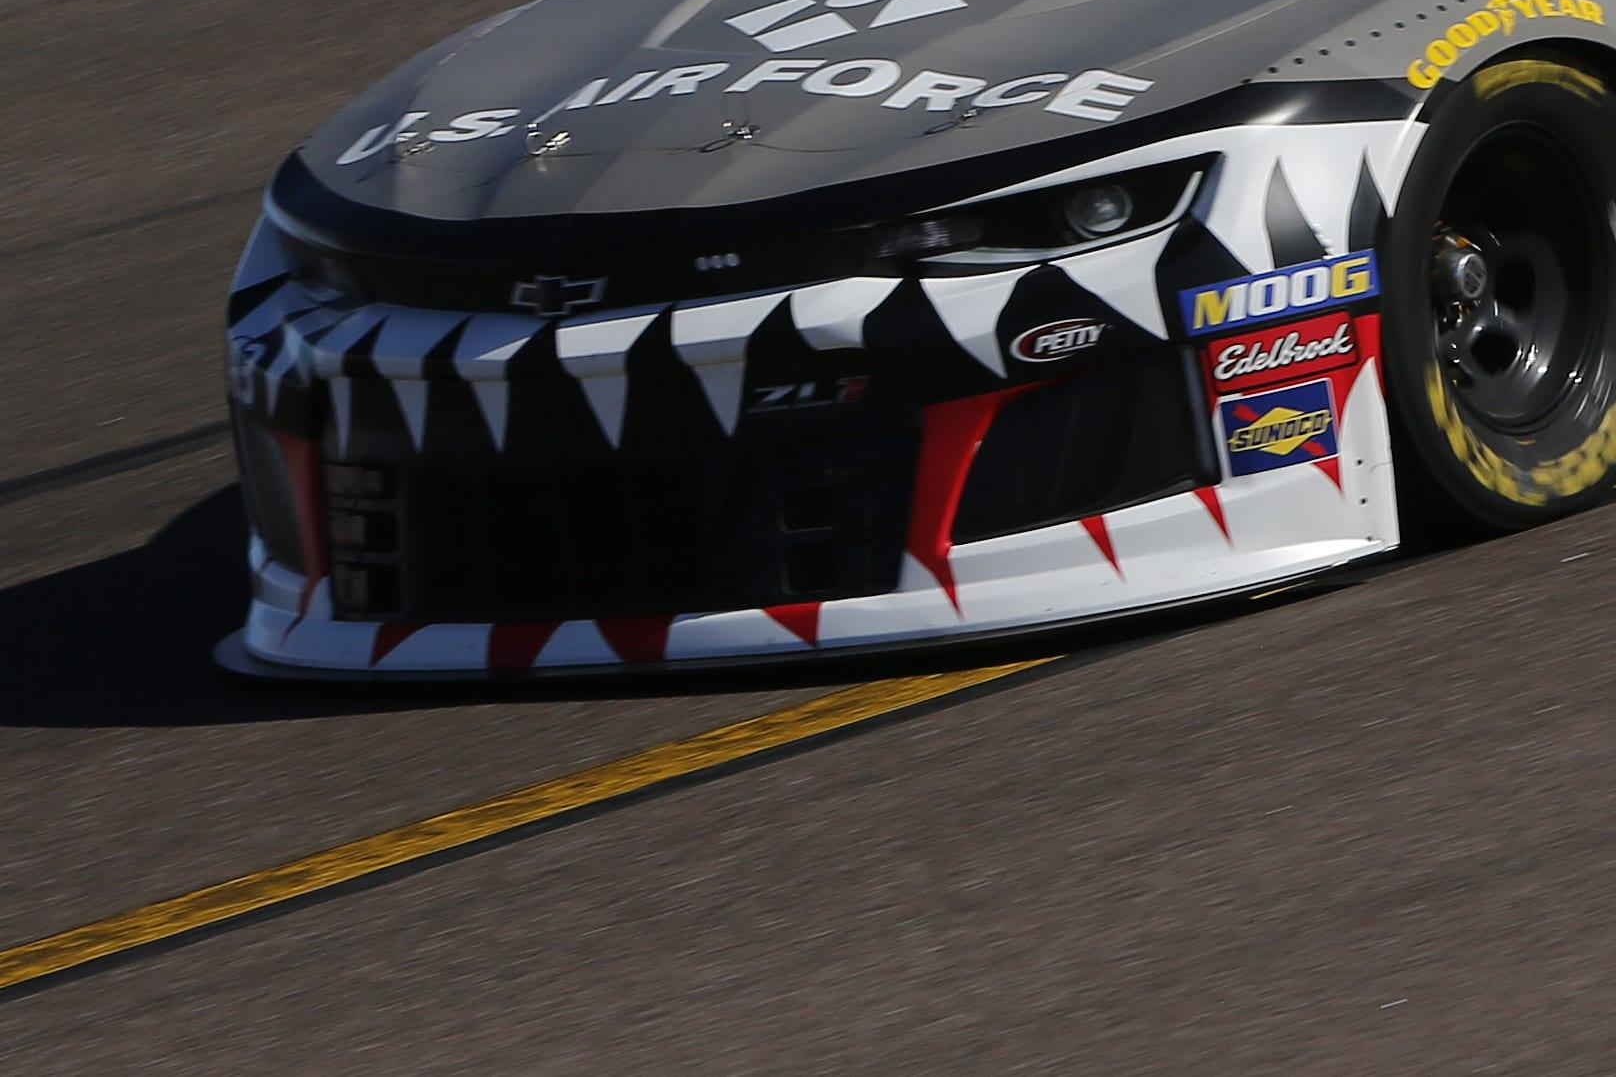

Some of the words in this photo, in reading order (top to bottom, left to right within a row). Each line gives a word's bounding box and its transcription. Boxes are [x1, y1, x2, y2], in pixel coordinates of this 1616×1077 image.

[335, 109, 521, 166] U.S.
[531, 63, 731, 128] AIR
[724, 58, 1154, 123] FORCE
[1192, 256, 1372, 329] MOOG
[1034, 324, 1106, 353] PETTY
[1213, 323, 1353, 380] Edelbrock
[1228, 411, 1332, 453] SUNOCO
